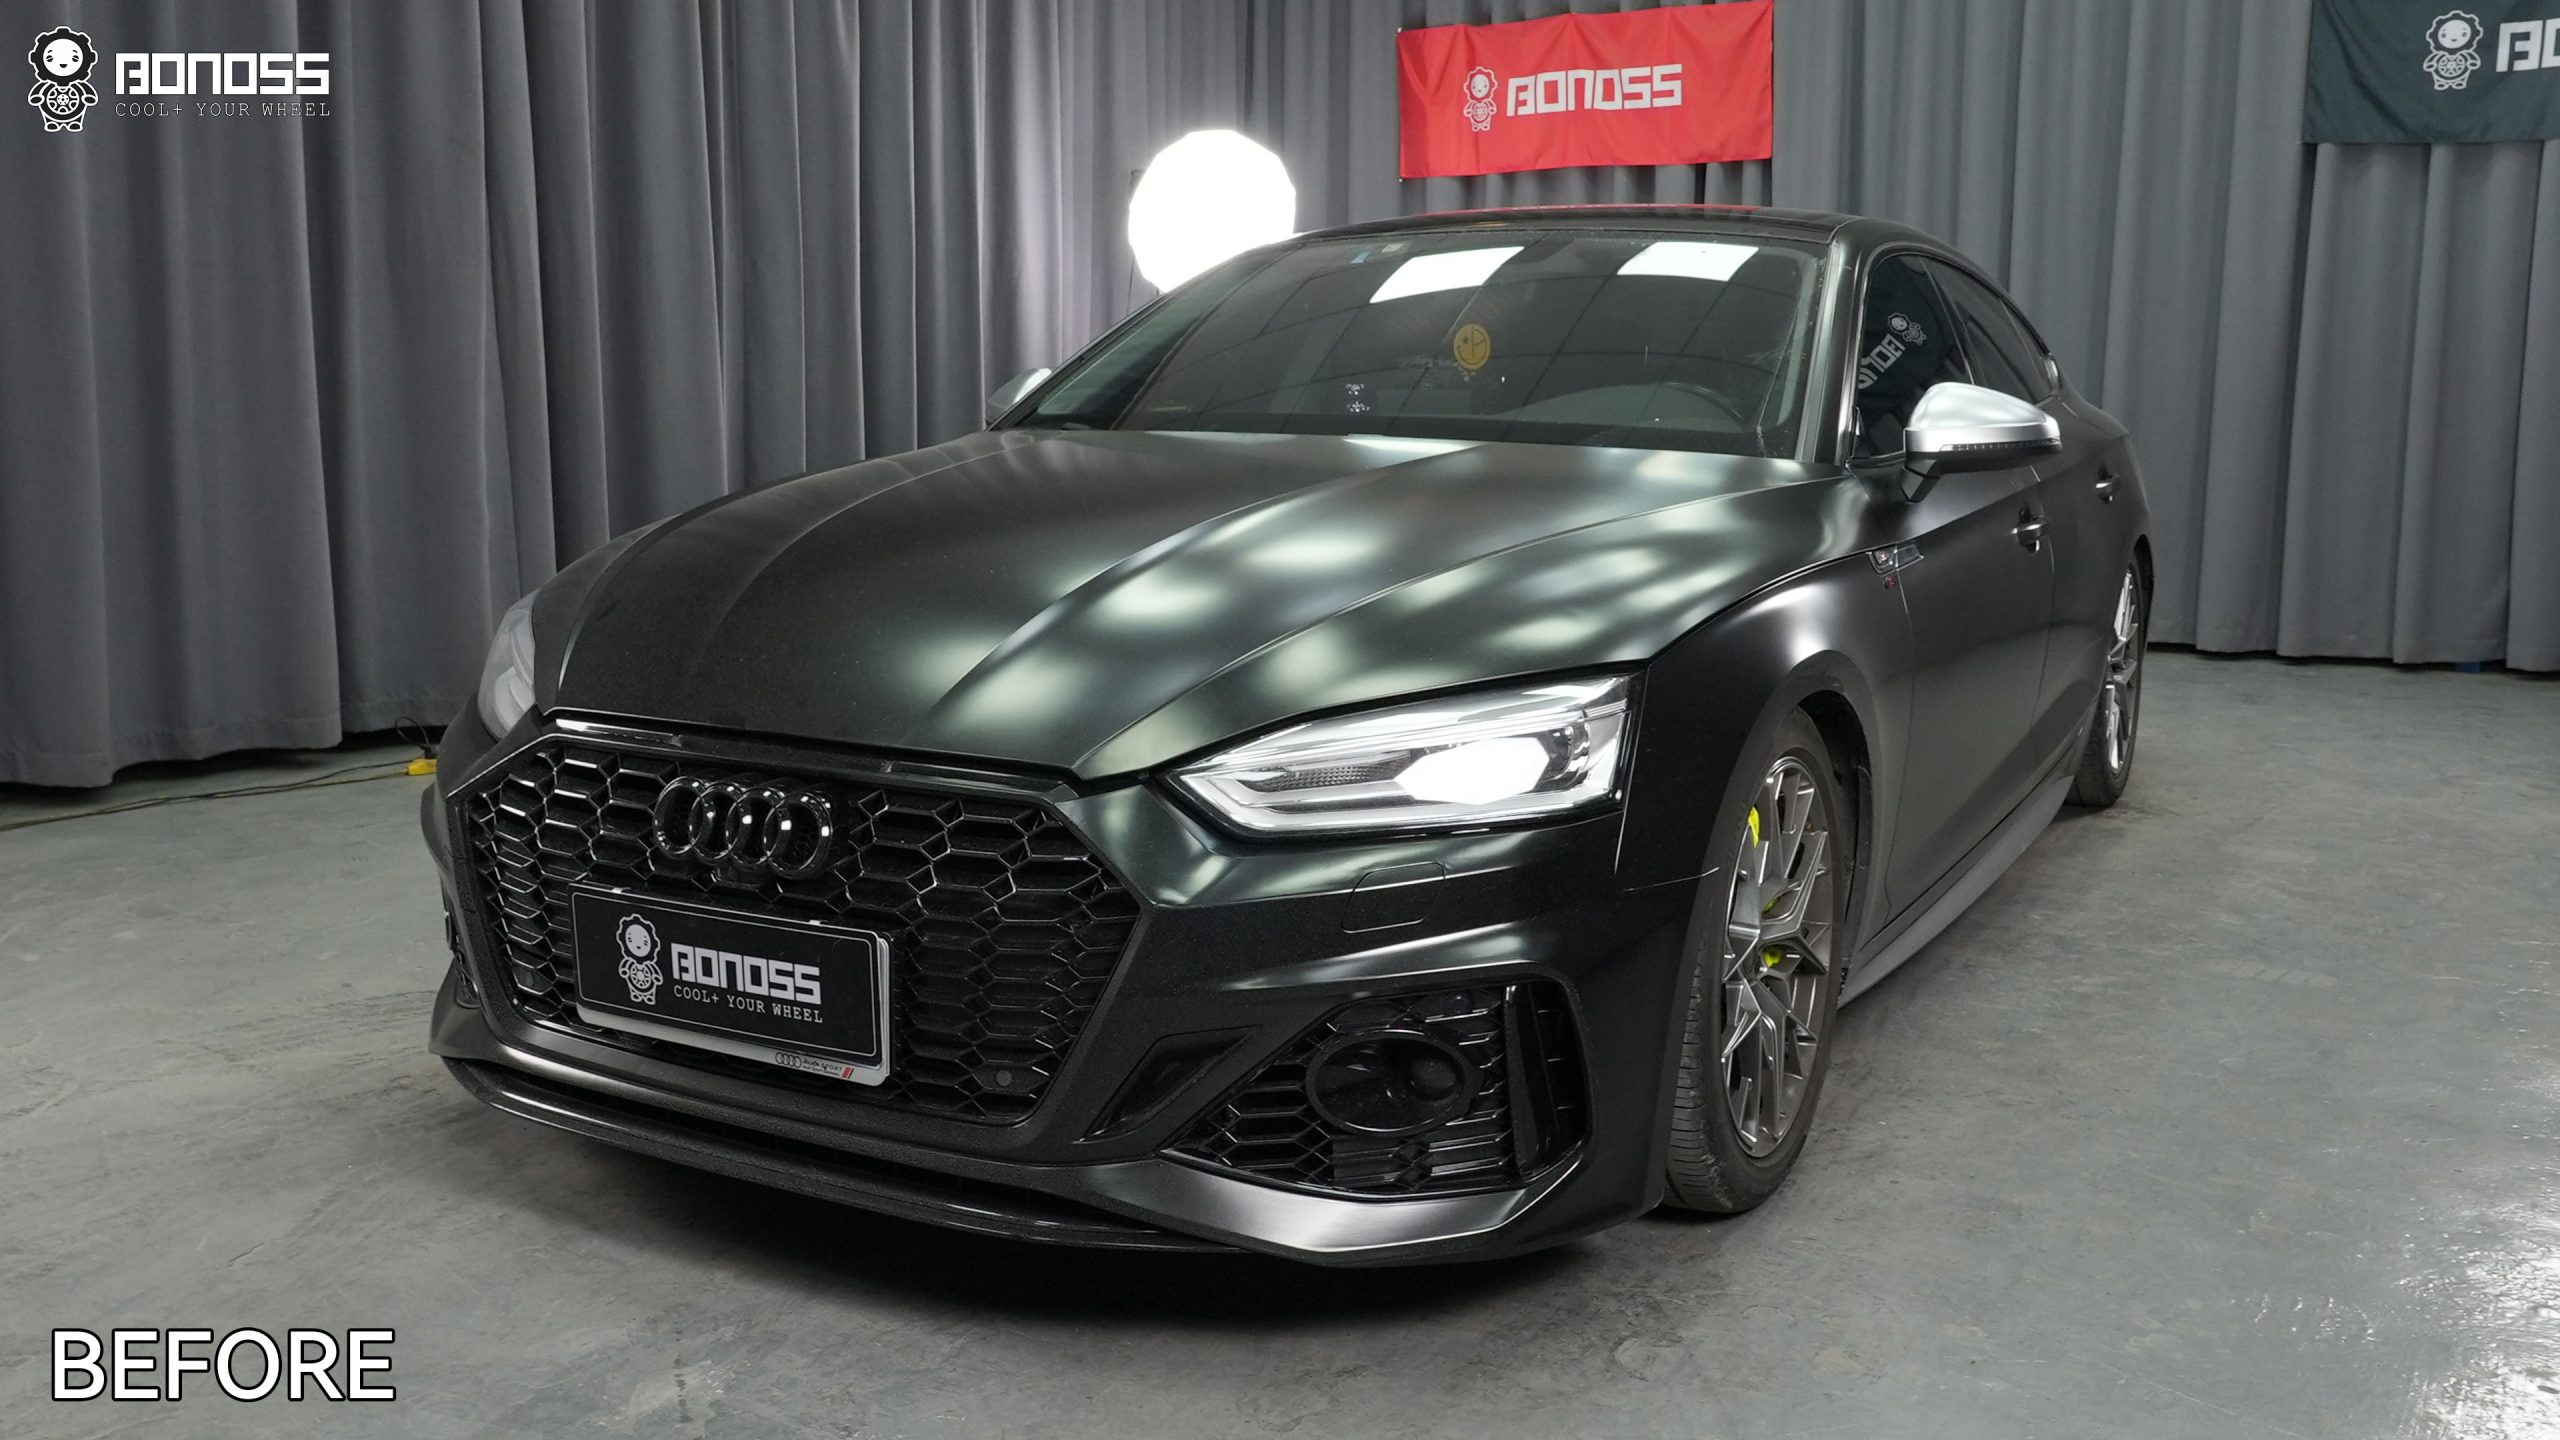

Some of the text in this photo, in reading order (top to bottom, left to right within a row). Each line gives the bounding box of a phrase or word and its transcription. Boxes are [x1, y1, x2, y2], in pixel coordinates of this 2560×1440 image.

[1507, 63, 1682, 116] BONOSS
[671, 943, 821, 1004] BONOSS
[673, 984, 823, 1024] COOL+ YOUR WHEEL
